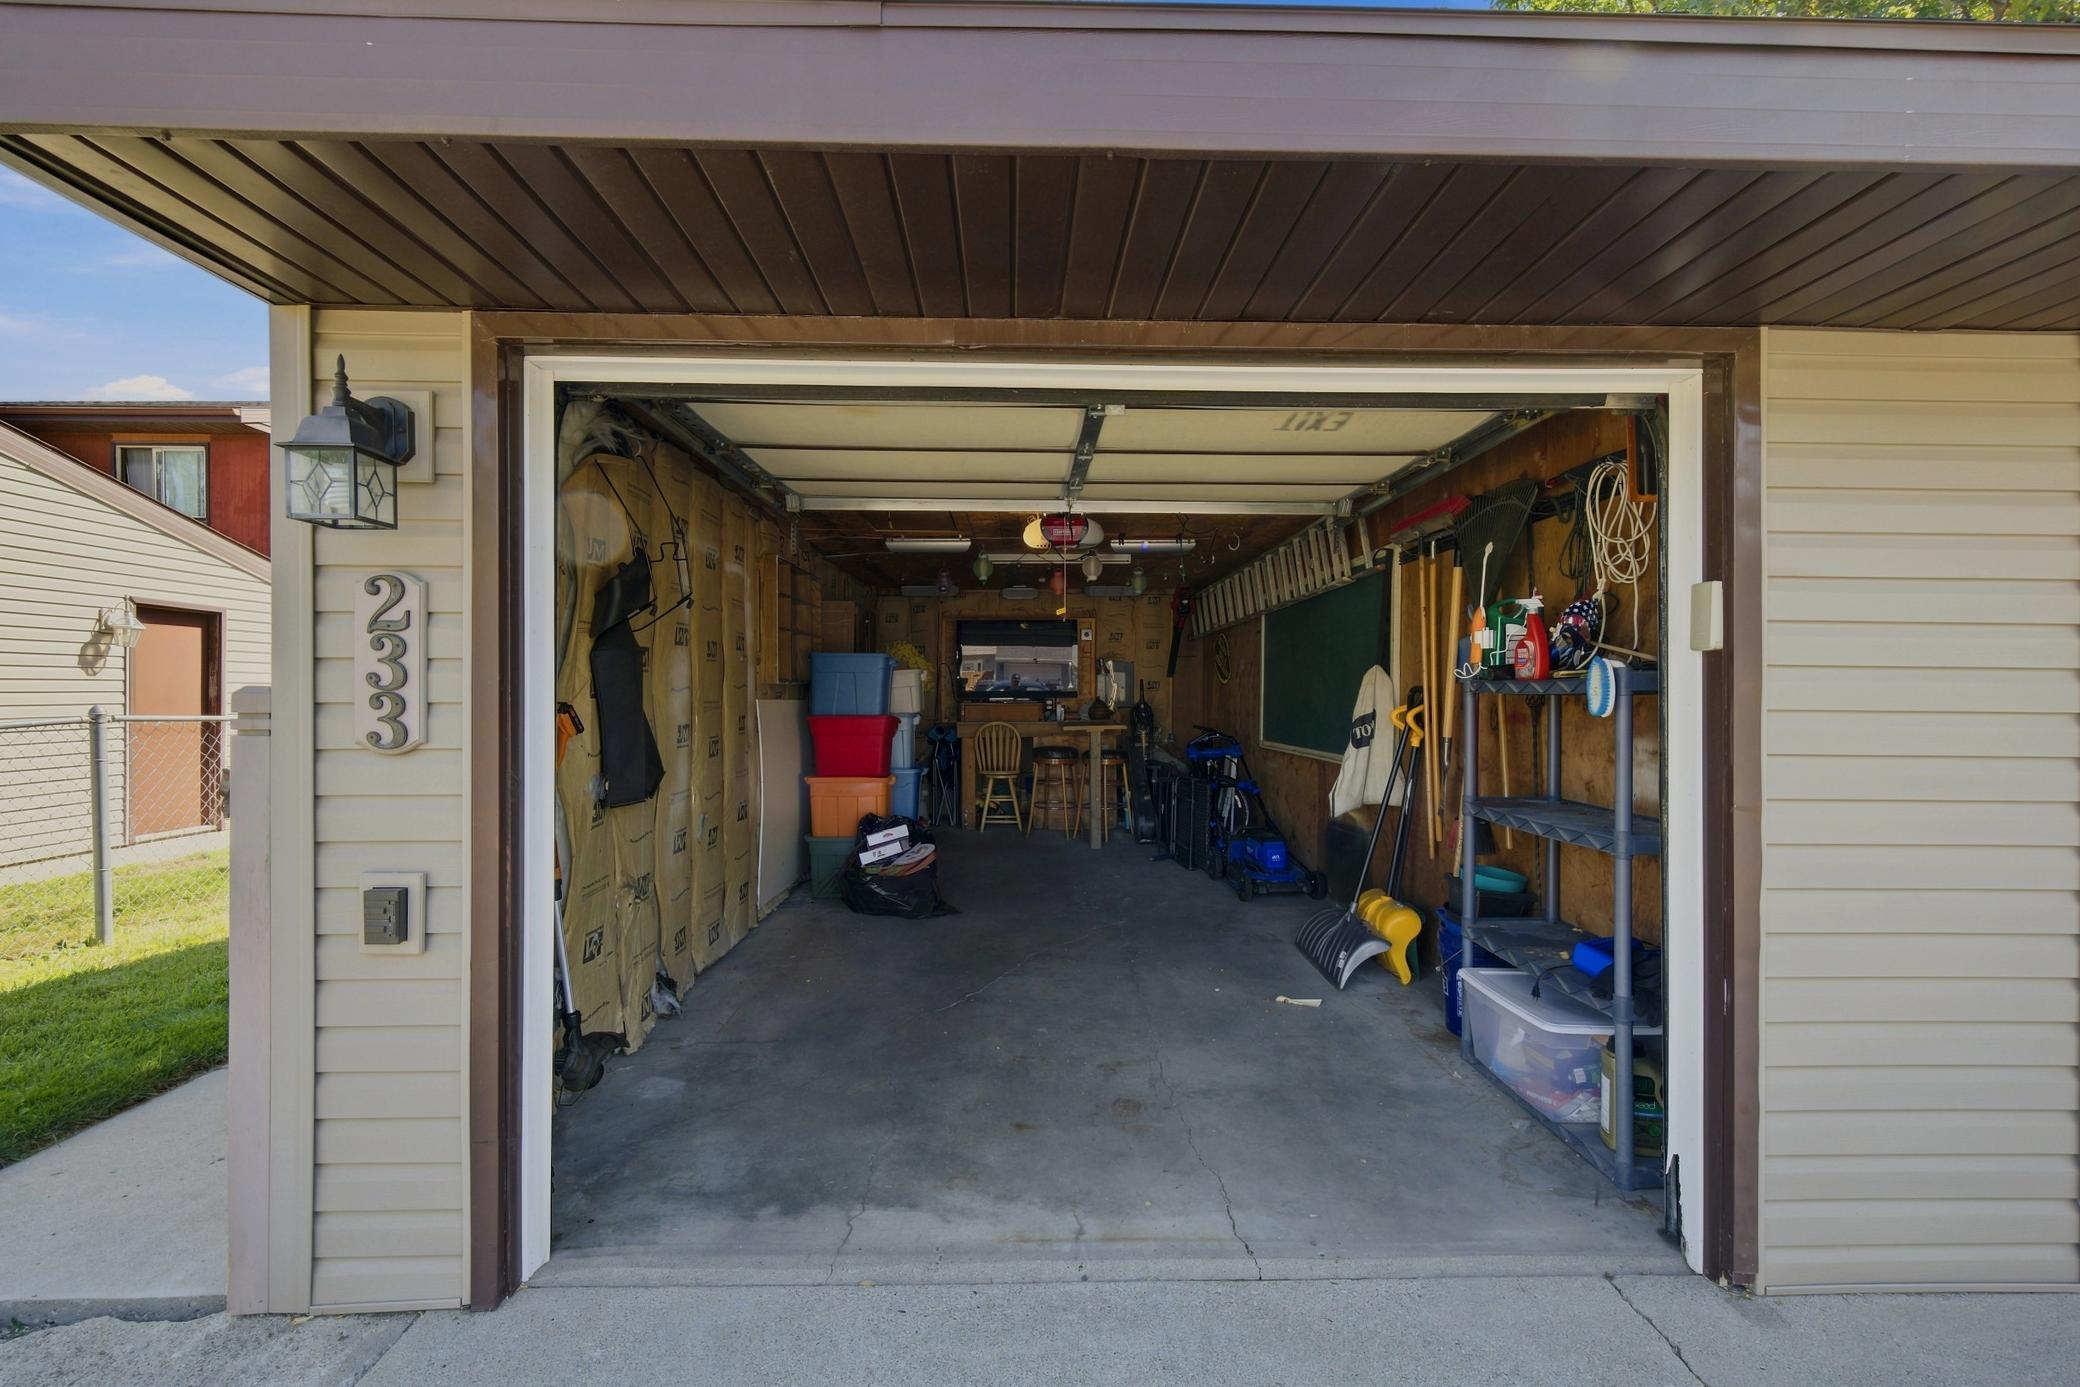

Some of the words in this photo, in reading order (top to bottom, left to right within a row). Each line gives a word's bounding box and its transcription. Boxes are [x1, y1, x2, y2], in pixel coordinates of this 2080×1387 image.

[1272, 411, 1354, 431] EXIT
[364, 574, 411, 749] 233
[1352, 720, 1375, 739] TO
